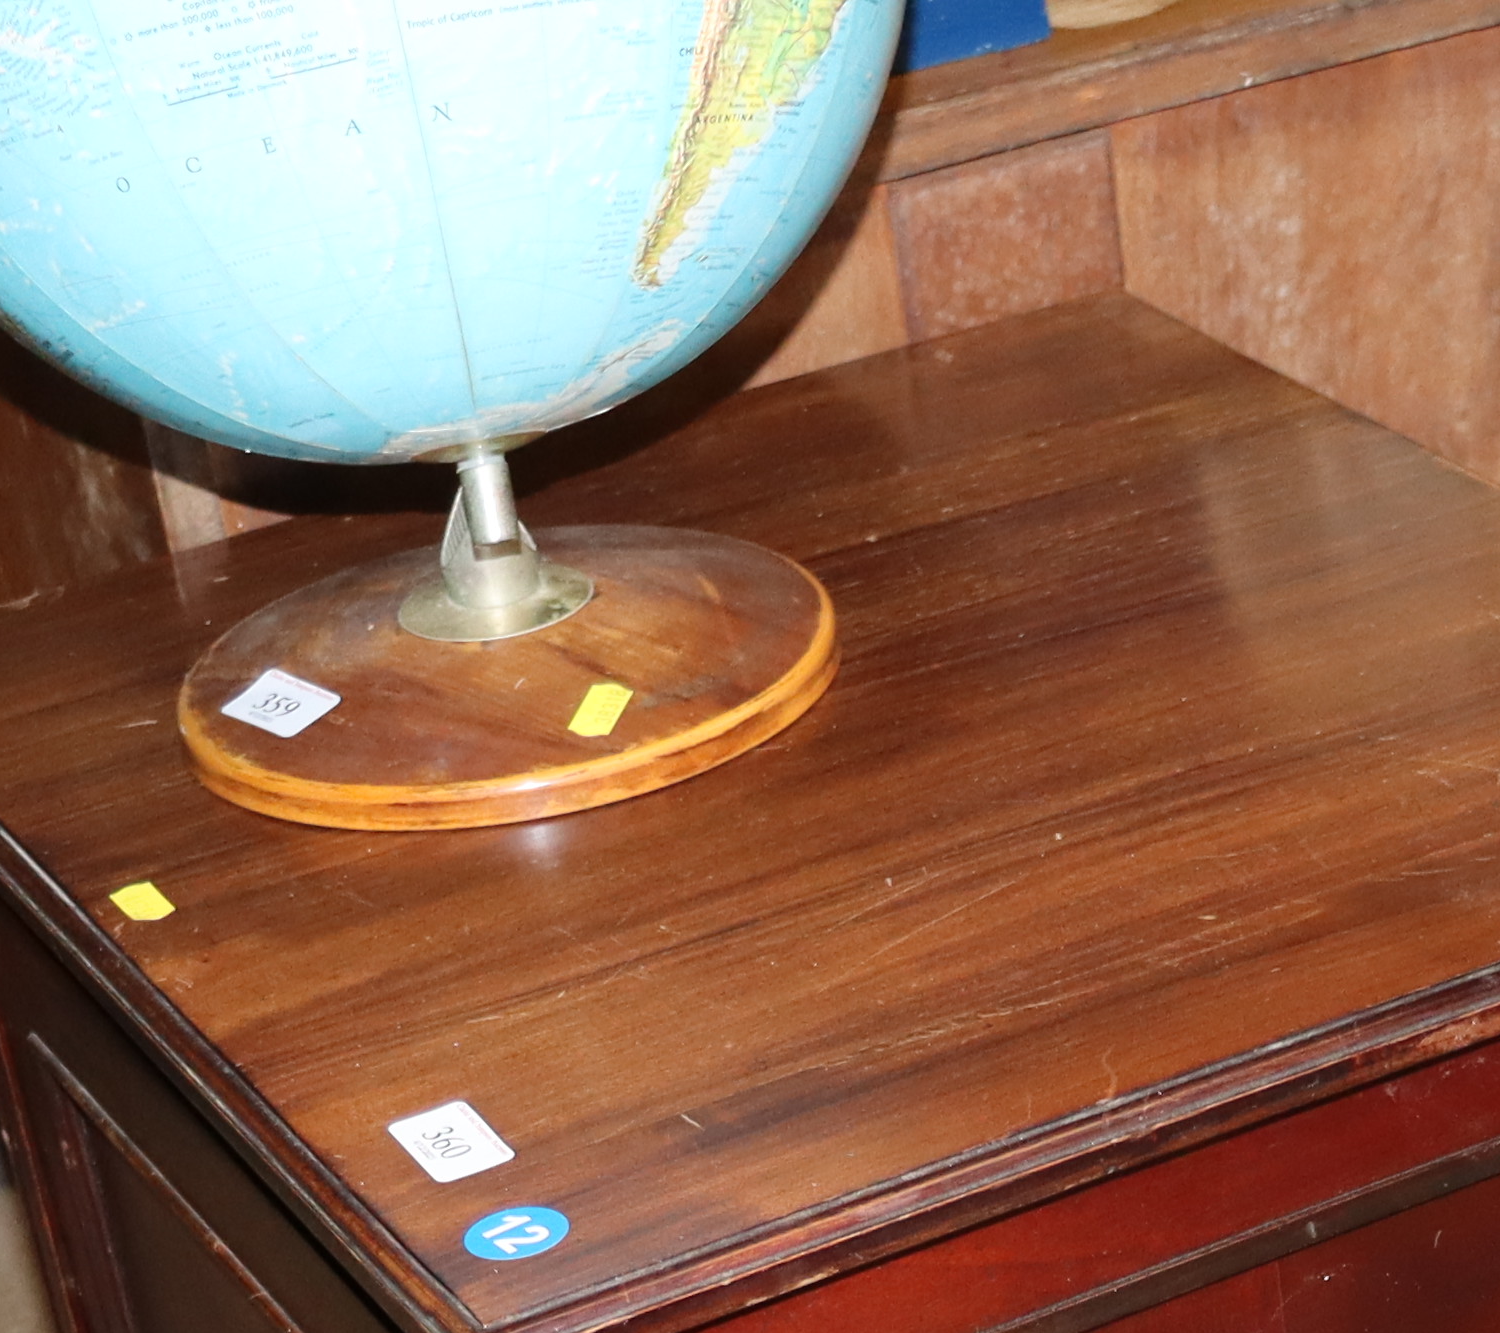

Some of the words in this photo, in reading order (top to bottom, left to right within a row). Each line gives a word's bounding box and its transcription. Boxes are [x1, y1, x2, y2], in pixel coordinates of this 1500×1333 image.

[160, 20, 180, 31] than
[215, 20, 232, 31] less
[234, 15, 254, 27] than
[406, 18, 436, 31] Tropic
[438, 13, 448, 24] of
[450, 7, 493, 22] Capricorn
[213, 48, 243, 61] Ocean
[245, 39, 282, 55] Currents
[192, 64, 226, 81] Natural
[227, 59, 252, 72] Scale
[252, 693, 301, 717] 359
[421, 1126, 472, 1159] 360
[481, 1214, 550, 1255] 12
